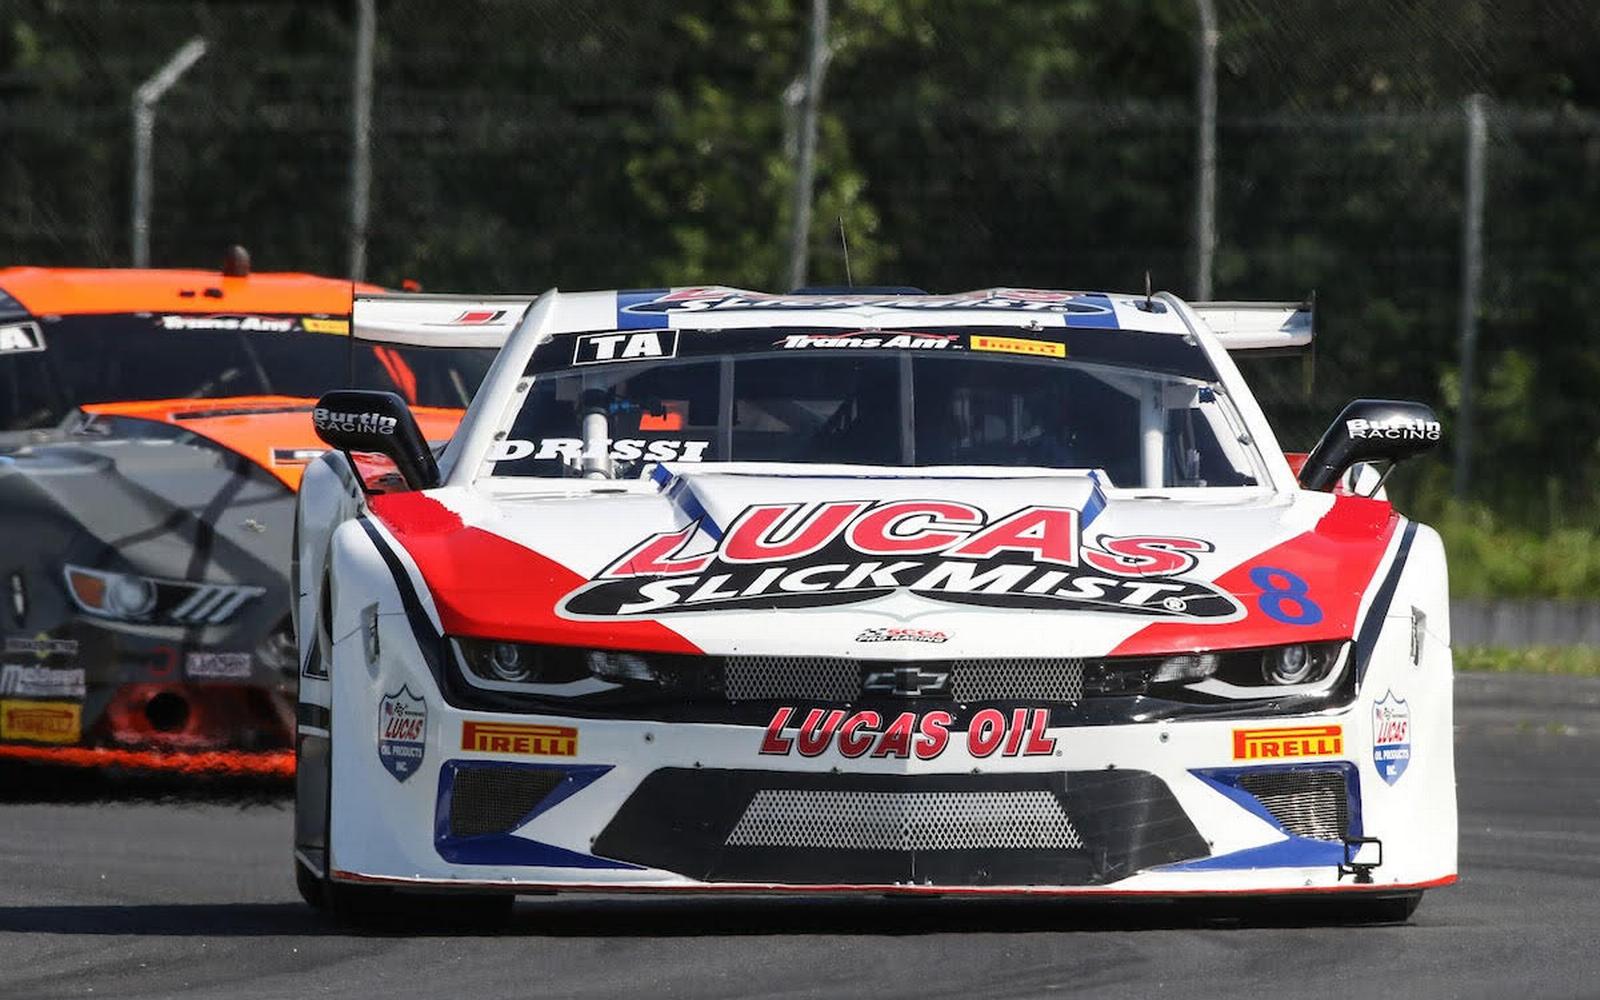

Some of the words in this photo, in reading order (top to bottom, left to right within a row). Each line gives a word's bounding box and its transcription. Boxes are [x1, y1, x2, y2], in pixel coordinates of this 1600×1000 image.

[590, 333, 663, 360] TA
[784, 334, 883, 349] Trans
[881, 335, 951, 349] Am
[313, 408, 397, 427] Burtin
[316, 421, 394, 435] RACING
[1346, 418, 1440, 432] Burtin
[1349, 429, 1440, 440] RACING
[590, 500, 1215, 580] LUCAS
[1250, 566, 1323, 625] 8
[384, 717, 424, 740] LUCAS
[462, 721, 577, 756] PIRELLI
[759, 707, 952, 760] LUCAS
[966, 707, 1057, 757] OIL
[1377, 721, 1407, 744] LUCAS
[1234, 726, 1342, 759] PIRELLI
